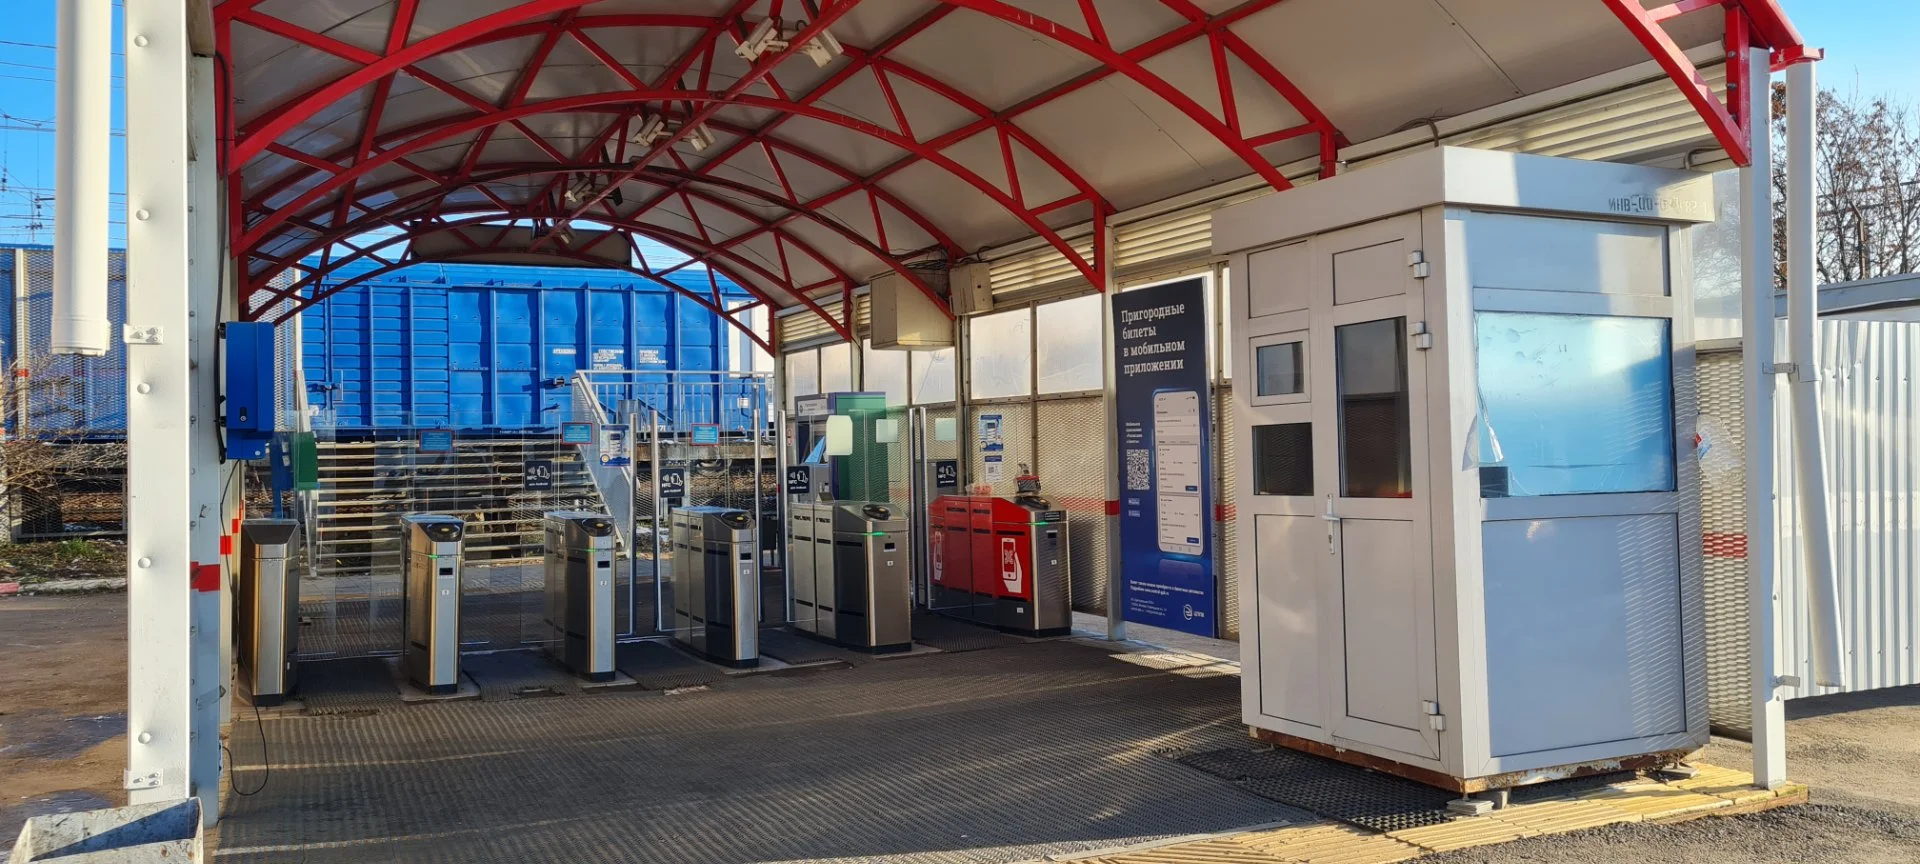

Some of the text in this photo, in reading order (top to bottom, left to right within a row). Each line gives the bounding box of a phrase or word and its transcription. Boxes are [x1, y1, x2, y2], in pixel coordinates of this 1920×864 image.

[1121, 304, 1185, 325] Пригородные
[1122, 326, 1157, 340] билеты
[1123, 340, 1186, 357] в мобильном
[1123, 359, 1184, 377] приложении
